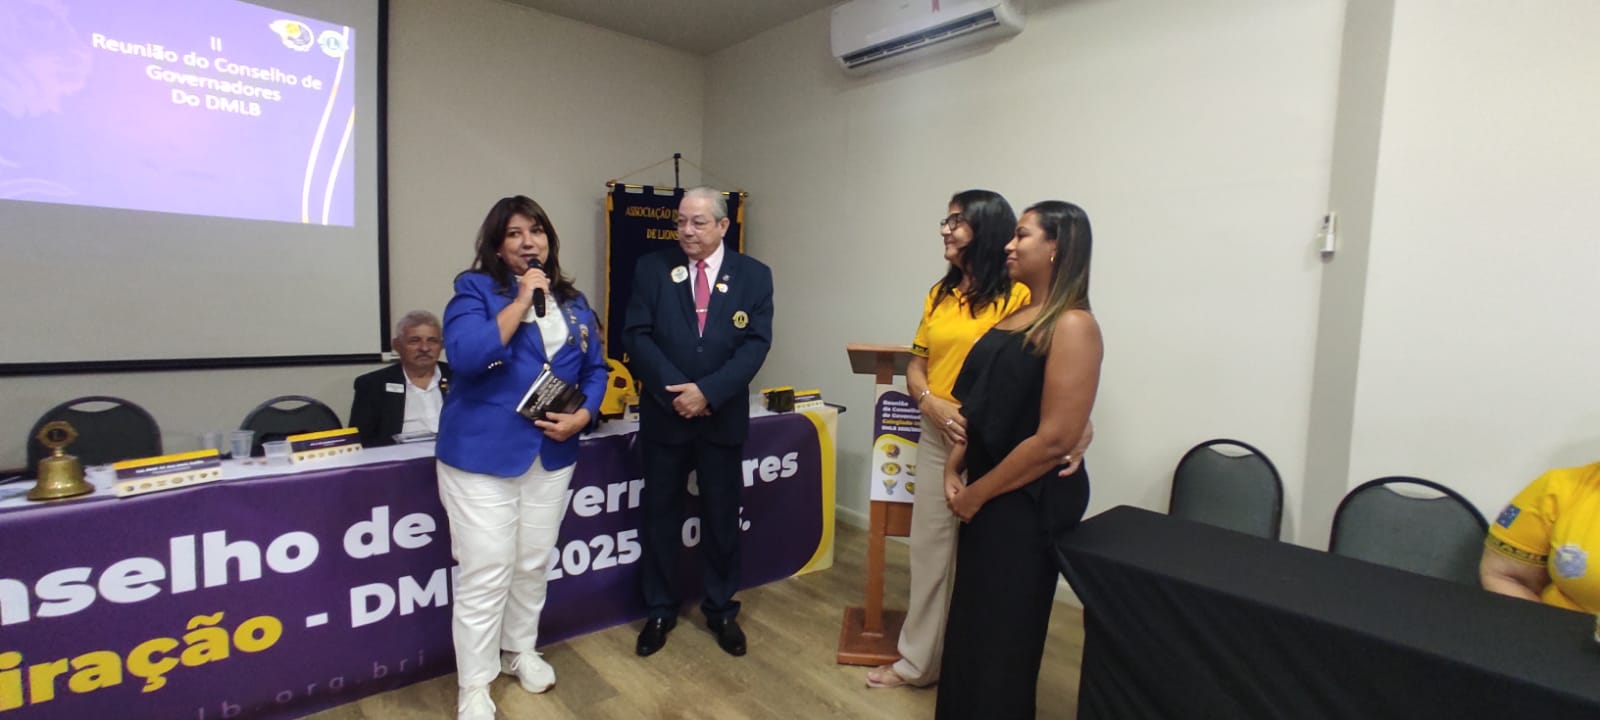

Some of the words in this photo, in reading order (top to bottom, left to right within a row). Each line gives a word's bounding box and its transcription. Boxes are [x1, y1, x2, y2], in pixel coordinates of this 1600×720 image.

[92, 32, 178, 62] Reunião
[183, 51, 210, 69] do
[214, 57, 298, 86] Conselho
[301, 74, 323, 90] de
[145, 63, 282, 102] Governadores
[172, 88, 200, 107] Do
[205, 94, 262, 117] DMLB
[343, 505, 437, 560] de
